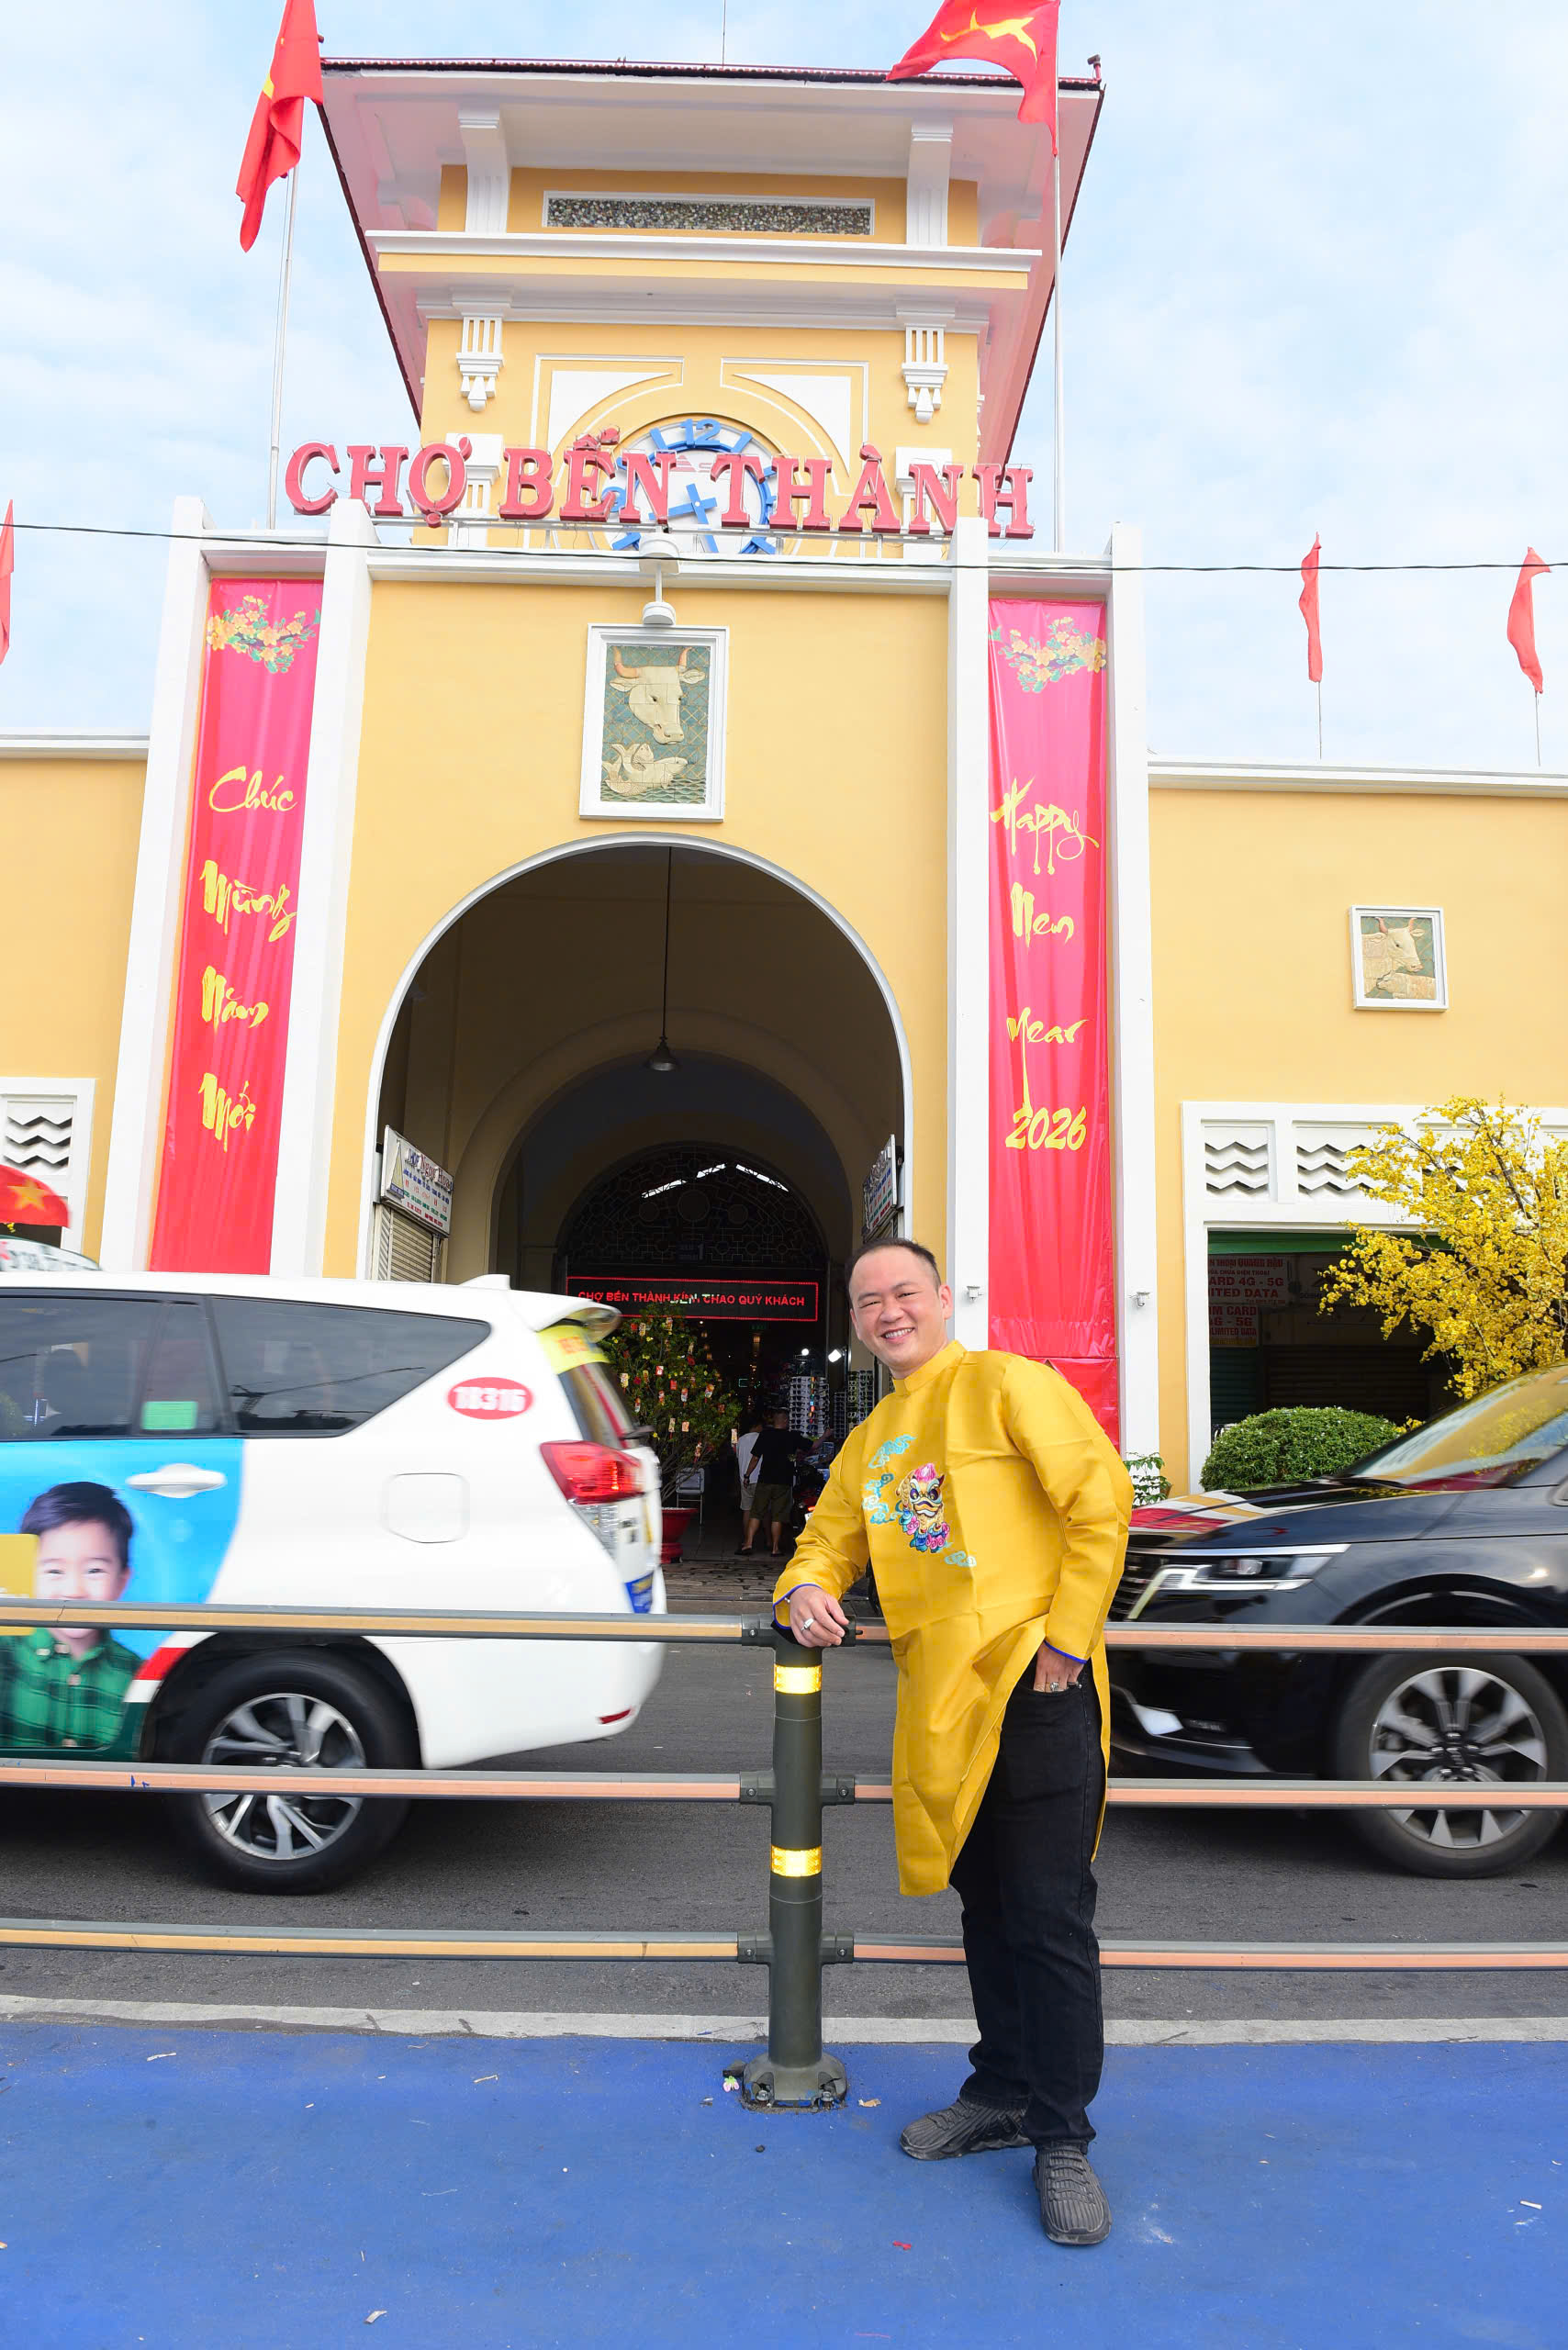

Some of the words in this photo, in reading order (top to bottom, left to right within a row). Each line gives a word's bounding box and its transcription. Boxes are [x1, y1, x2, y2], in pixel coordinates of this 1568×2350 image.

[680, 419, 722, 445] 12
[285, 437, 473, 529] CHỢ
[498, 426, 678, 525] BẾN
[711, 443, 1035, 539] THÀNH
[208, 766, 298, 813] Chúc
[990, 778, 1100, 875] Happy
[199, 859, 298, 943] Mừng
[201, 965, 269, 1035] Năm
[1006, 1006, 1090, 1108] Year
[198, 1072, 257, 1152] Mới
[1005, 1105, 1086, 1150] 2026
[632, 1291, 671, 1304] THÀNH
[738, 1293, 763, 1305] QUÝ
[765, 1293, 805, 1306] KHÁCH
[1209, 1277, 1236, 1285] ARD
[1238, 1277, 1256, 1285] 4G
[1267, 1277, 1284, 1286] 5G
[1244, 1289, 1279, 1298] DATA
[1209, 1306, 1224, 1315] IM
[1226, 1306, 1258, 1315] CARD
[1210, 1327, 1239, 1337] LIMITED
[1236, 1317, 1253, 1326] 5G
